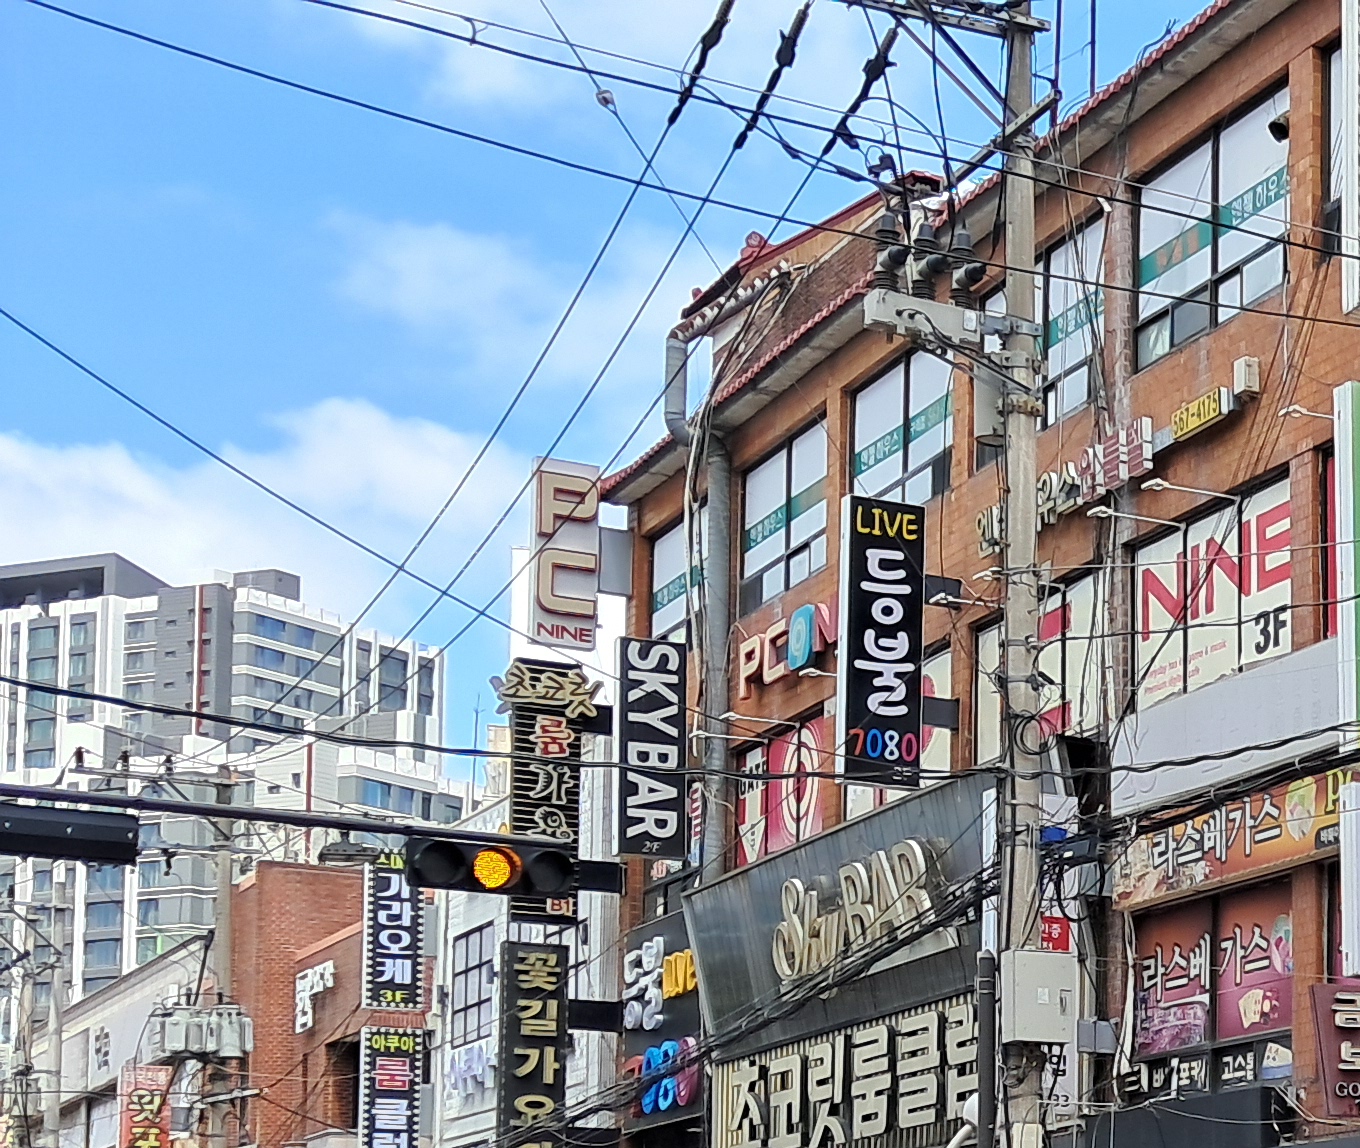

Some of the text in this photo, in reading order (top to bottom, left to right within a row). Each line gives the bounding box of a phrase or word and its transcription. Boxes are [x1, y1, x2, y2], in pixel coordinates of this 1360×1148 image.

[537, 470, 600, 618] PC
[856, 505, 918, 541] LIVE
[1141, 499, 1292, 642] NINE
[536, 623, 593, 644] NINE
[1253, 606, 1288, 655] 3F
[625, 640, 679, 738] SKY
[849, 727, 918, 762] 7080
[622, 750, 679, 840] BAR
[1152, 794, 1283, 877] 라스베가스
[375, 872, 415, 984] 가라오케
[547, 898, 572, 915] B1
[378, 989, 410, 1003] 3F
[371, 1033, 414, 1053] 아쿠아
